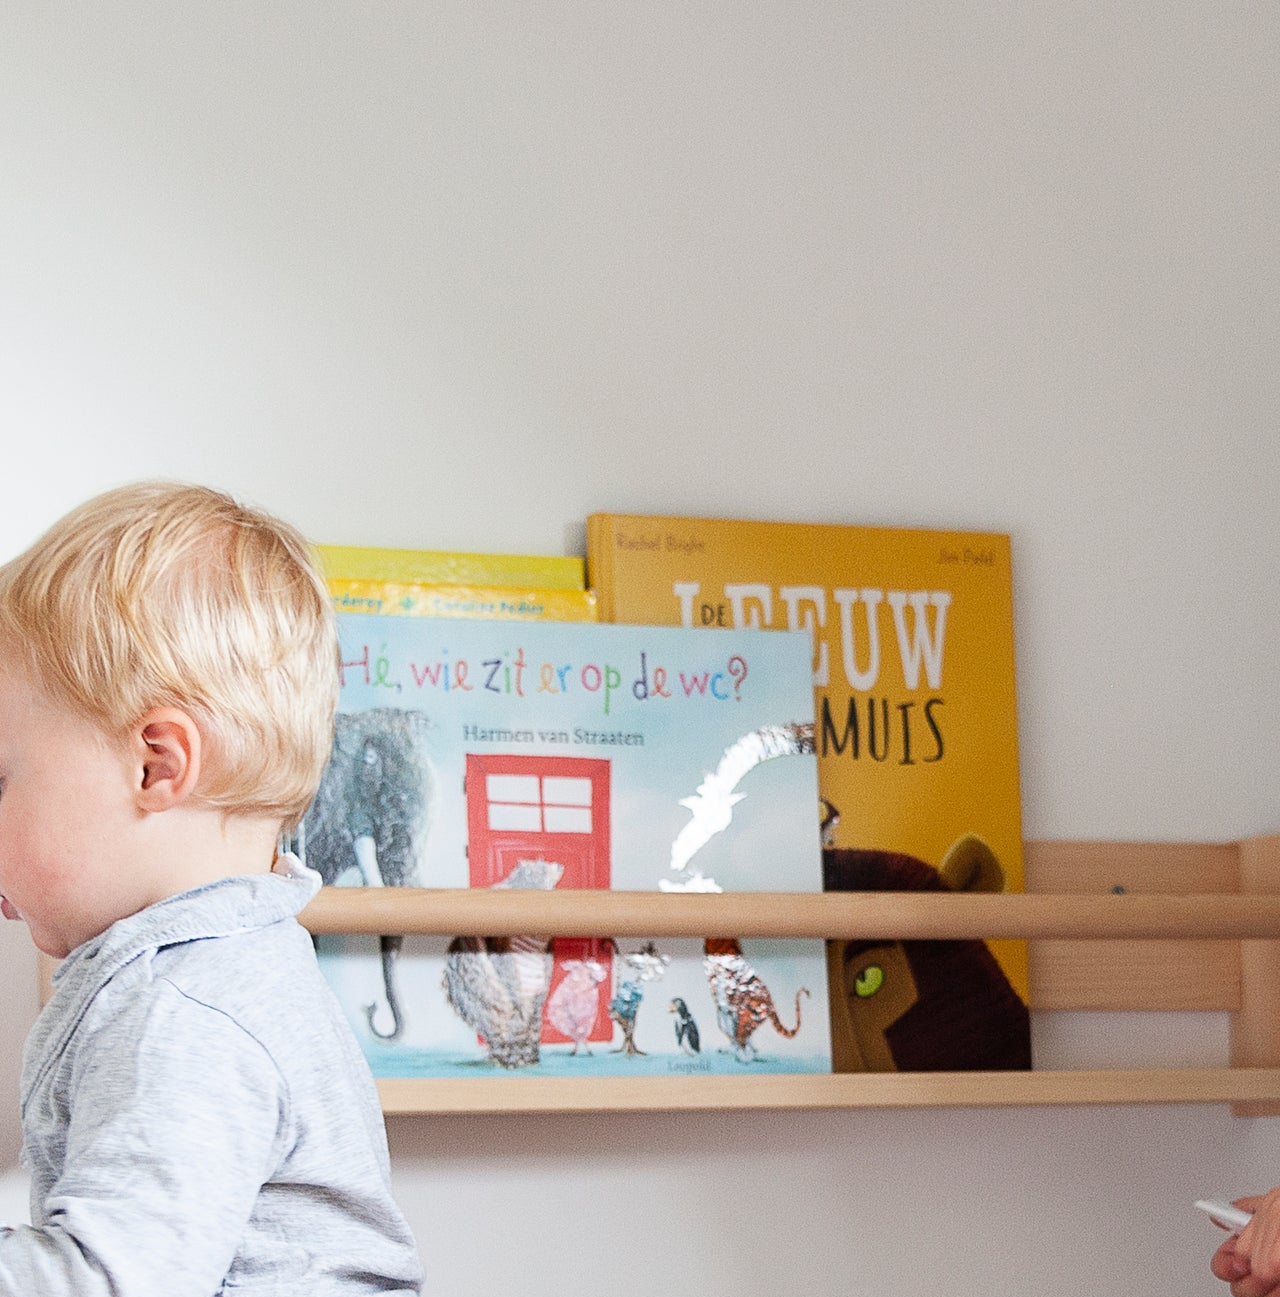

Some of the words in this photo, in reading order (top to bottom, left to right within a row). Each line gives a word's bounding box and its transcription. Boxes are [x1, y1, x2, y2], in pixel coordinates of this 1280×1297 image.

[701, 604, 725, 627] DE
[410, 648, 473, 692] wie
[482, 647, 527, 697] zit
[537, 662, 573, 695] er
[580, 663, 622, 716] op
[632, 652, 672, 701] de
[678, 655, 749, 702] wc?
[462, 724, 534, 744] Harmen
[539, 729, 569, 744] van
[573, 728, 645, 747] Straaten
[820, 697, 945, 765] MUIS
